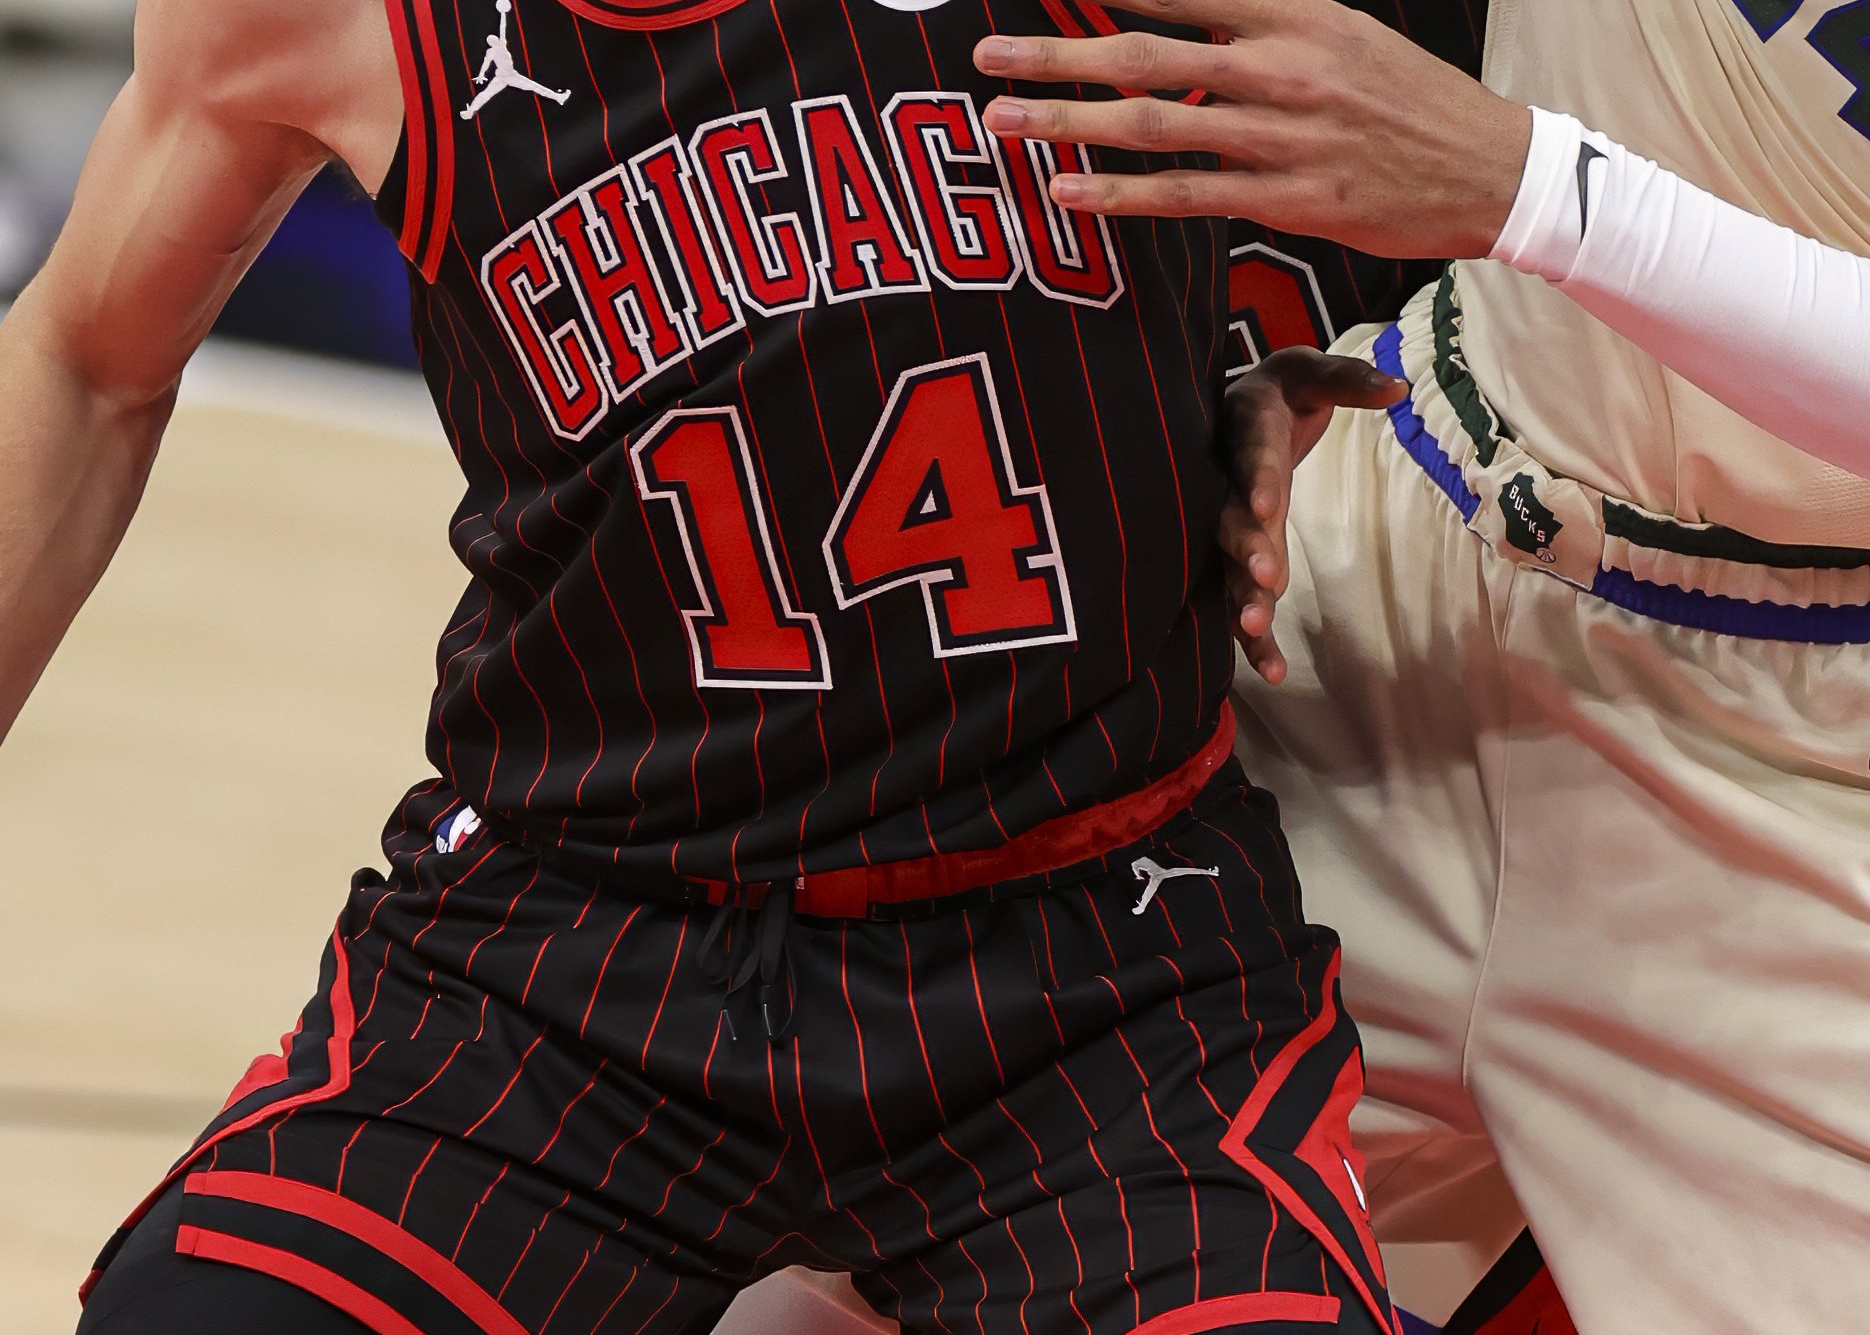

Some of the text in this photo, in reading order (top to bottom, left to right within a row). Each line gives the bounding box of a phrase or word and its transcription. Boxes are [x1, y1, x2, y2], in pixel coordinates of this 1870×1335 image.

[480, 92, 1126, 442] CHICAGO
[630, 352, 1080, 691] 14
[1508, 483, 1547, 543] BUCKS
